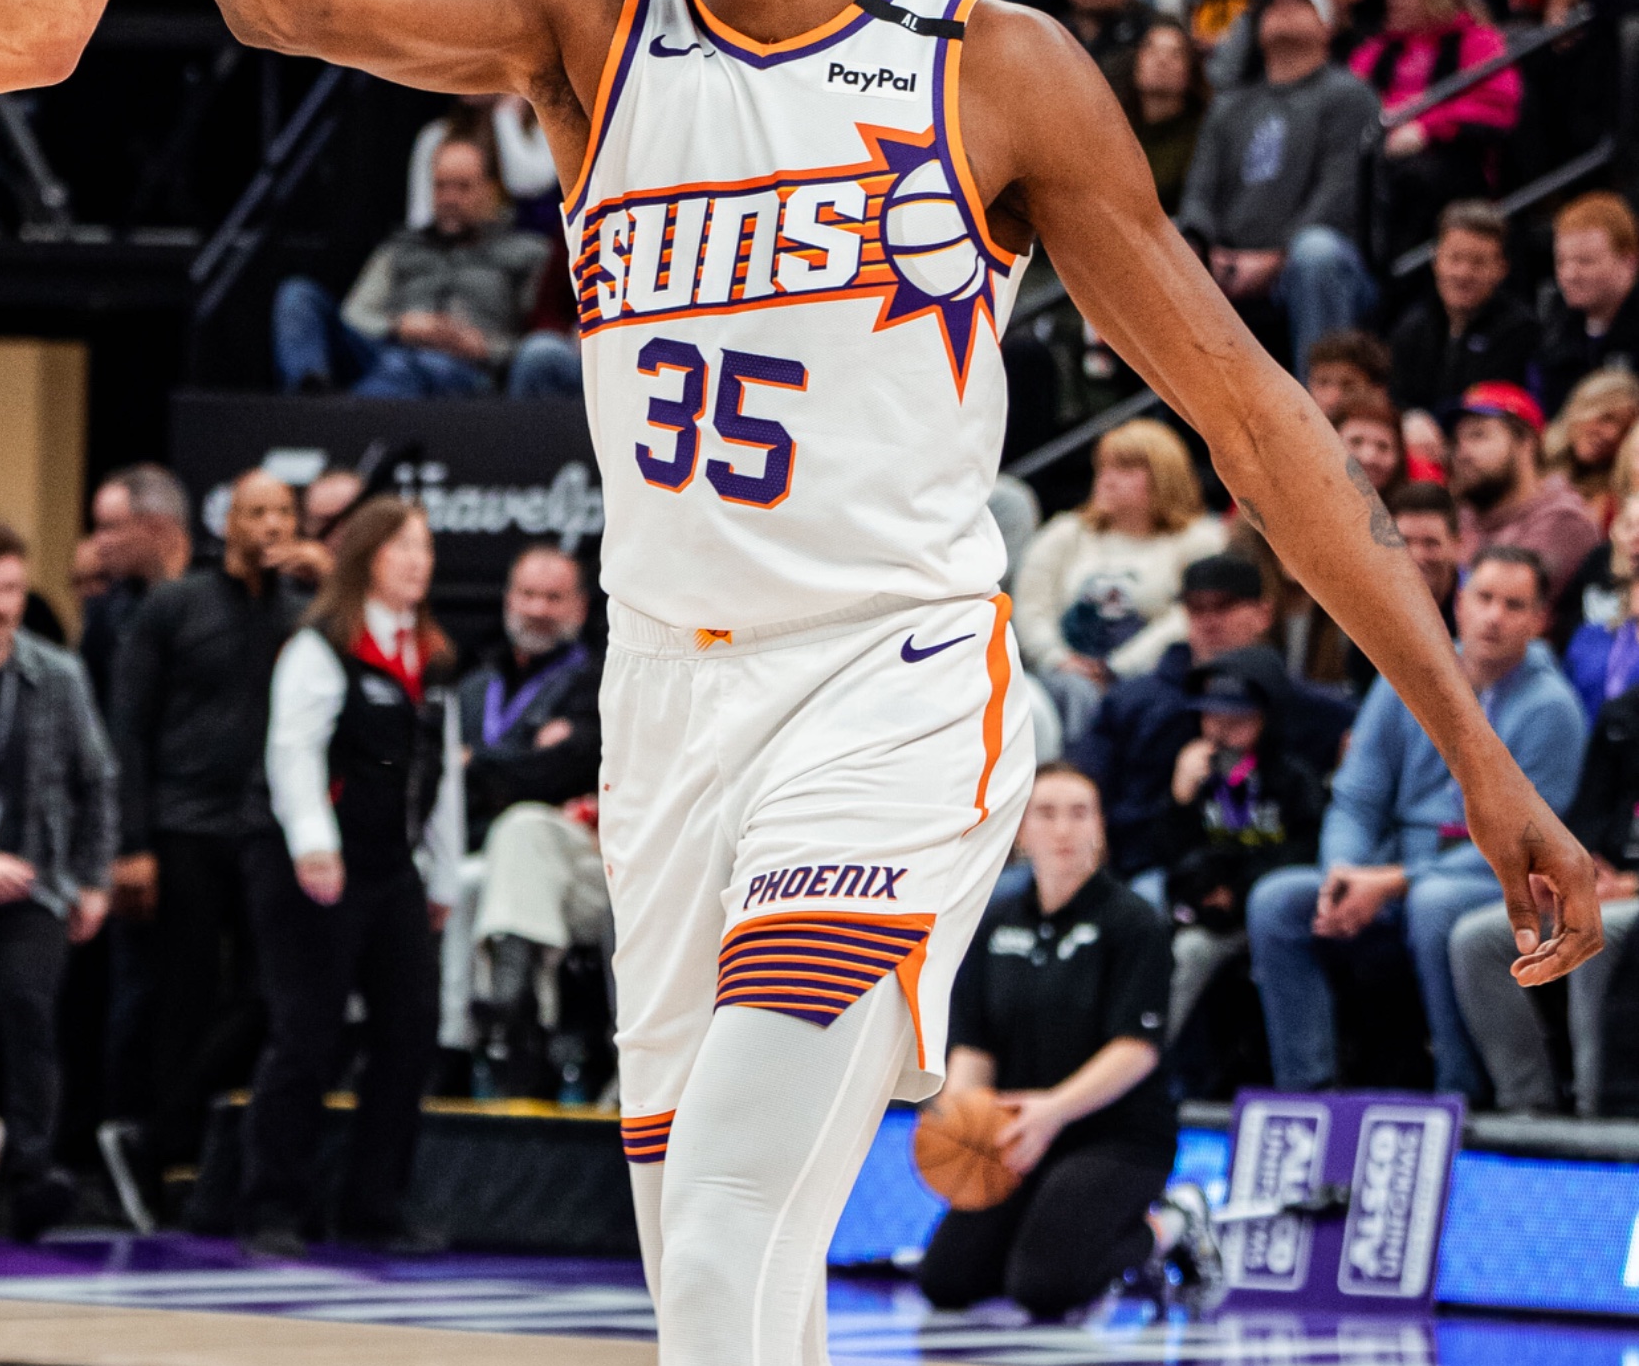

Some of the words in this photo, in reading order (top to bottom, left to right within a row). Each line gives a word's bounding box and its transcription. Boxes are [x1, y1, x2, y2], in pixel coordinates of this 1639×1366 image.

[900, 12, 920, 32] AL
[827, 61, 917, 93] PayPal
[596, 179, 867, 320] SUNS
[635, 337, 810, 511] 35
[742, 864, 908, 912] PHOENIX
[1348, 1122, 1400, 1279] ALSCO
